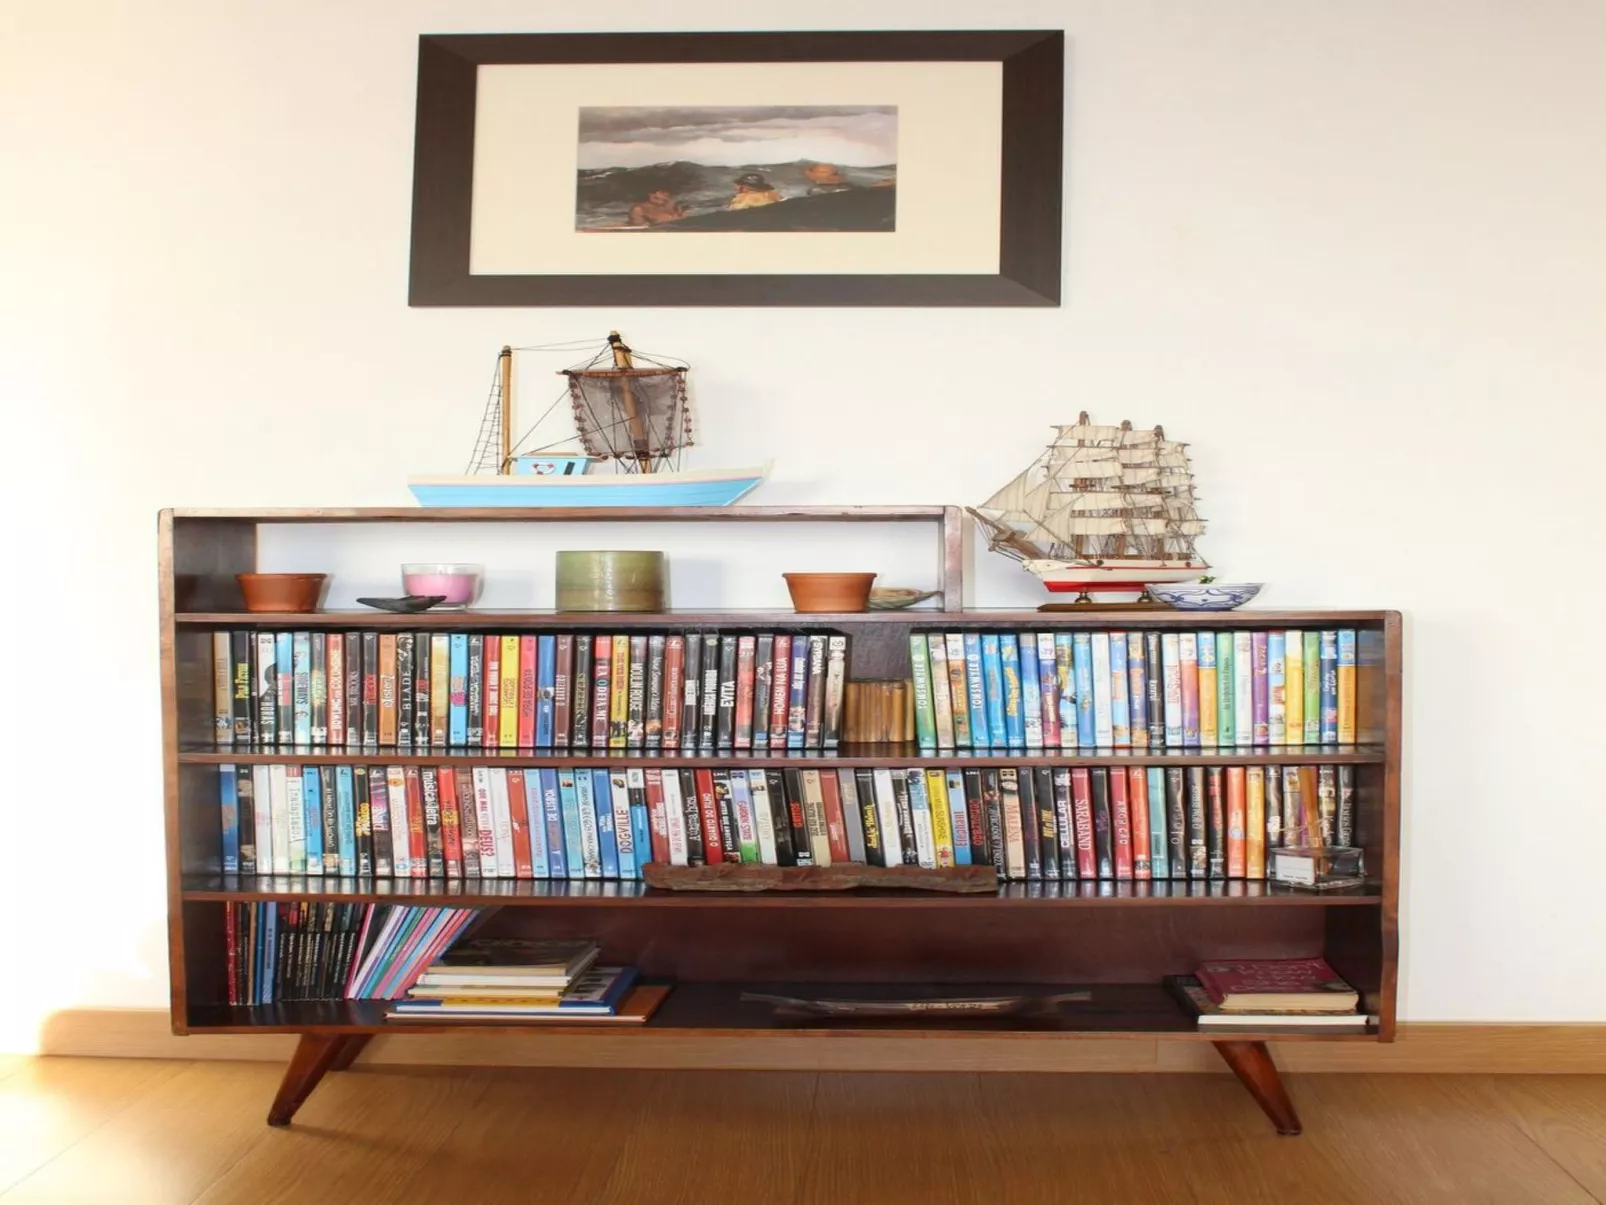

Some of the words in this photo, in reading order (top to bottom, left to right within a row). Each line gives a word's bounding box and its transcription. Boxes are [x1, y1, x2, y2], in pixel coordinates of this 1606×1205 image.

[630, 663, 643, 688] MOULIN
[777, 657, 787, 671] LUA
[296, 672, 308, 704] SIDEWAYS
[403, 671, 411, 710] BLADE
[777, 673, 786, 685] NA
[576, 673, 585, 713] SLEEPERS
[630, 689, 643, 711] ROUGE
[720, 681, 734, 707] EVITA
[775, 686, 785, 714] HOMEM
[331, 699, 341, 730] BOWLING
[545, 789, 556, 811] LISBOA
[703, 793, 713, 808] FILHO
[705, 809, 714, 817] DO
[548, 813, 557, 821] DE
[707, 819, 717, 841] QUARTO
[1058, 801, 1069, 848] CELLULAR
[1075, 799, 1091, 850] SARABAND
[479, 830, 494, 856] DEUS?
[616, 810, 632, 853] DOGVILLE
